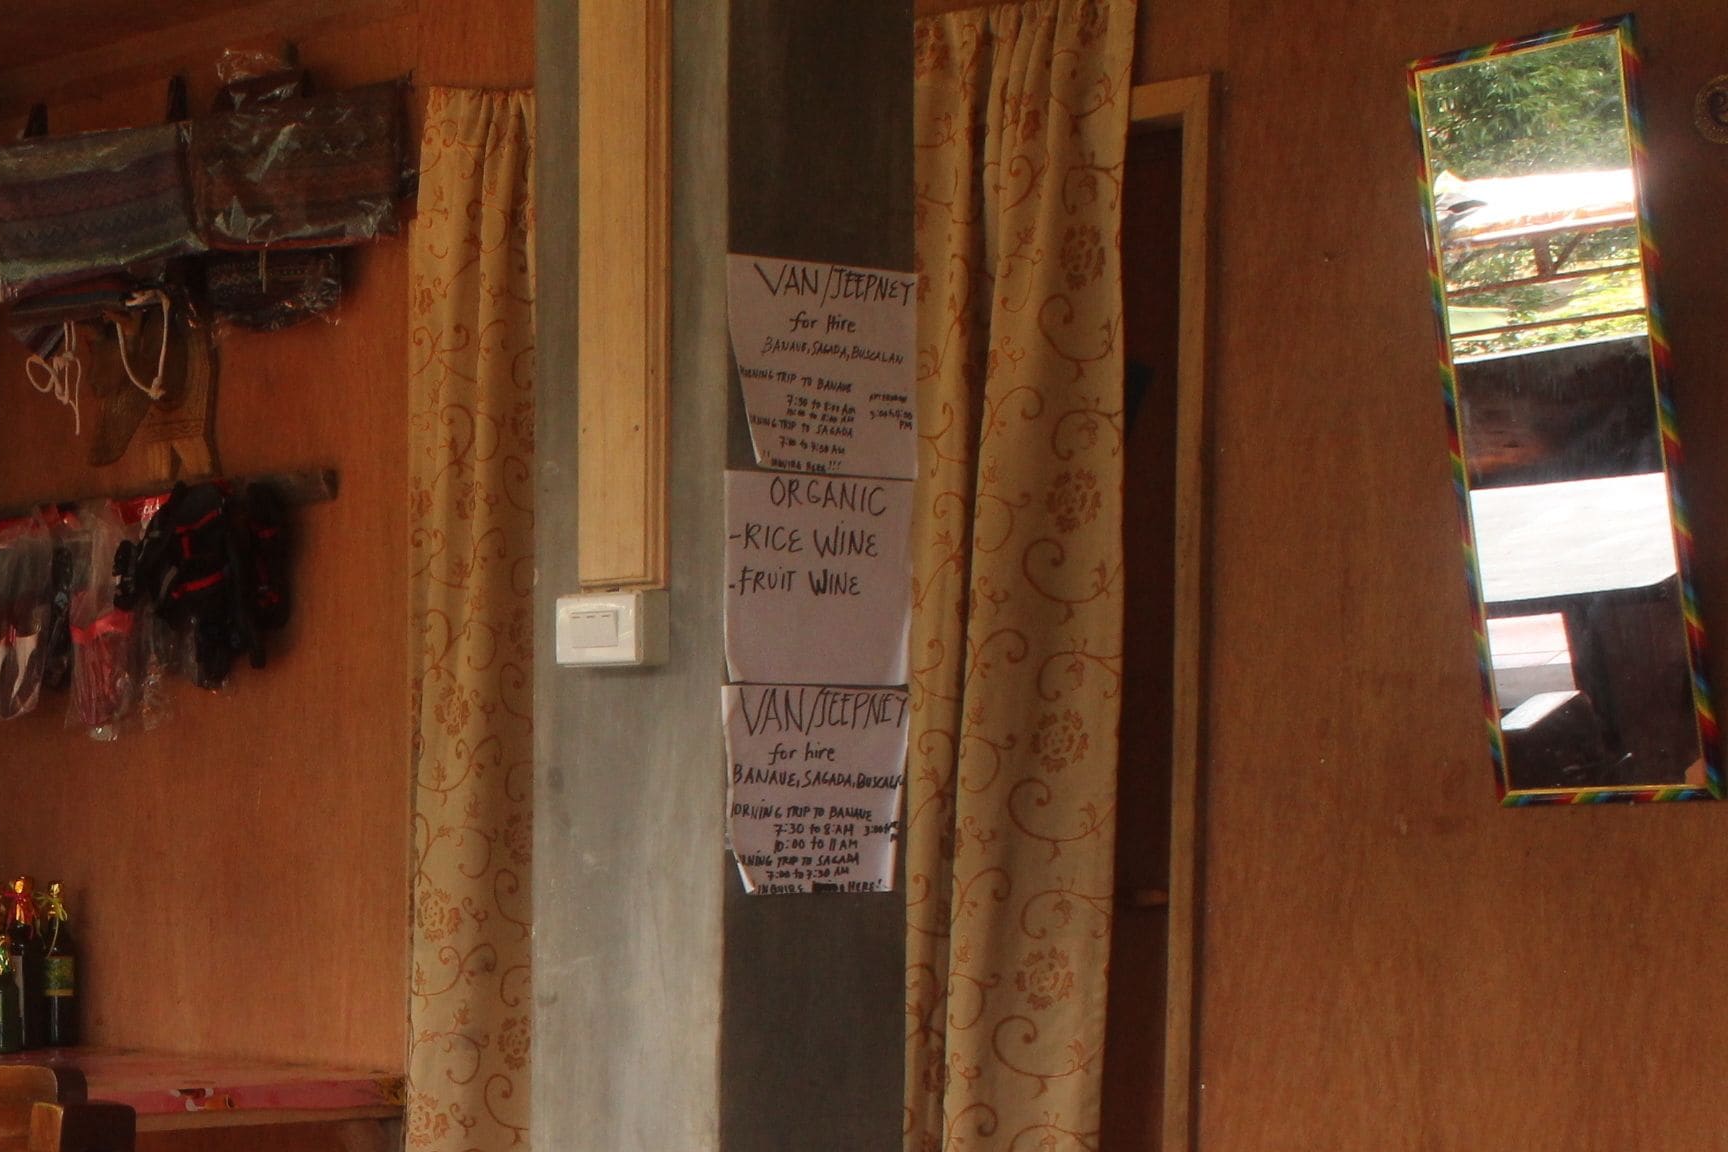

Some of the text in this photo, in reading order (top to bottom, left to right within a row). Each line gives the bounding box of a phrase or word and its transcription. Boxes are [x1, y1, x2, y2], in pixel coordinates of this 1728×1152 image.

[789, 311, 817, 333] for
[777, 371, 797, 385] TRIP
[801, 377, 812, 387] TO
[770, 476, 888, 516] ORGANIC
[813, 522, 878, 557] WINE
[808, 569, 861, 596] WINE
[769, 742, 836, 765] for hire
[787, 806, 810, 818] TRIP
[813, 807, 824, 819] TO
[829, 805, 872, 822] BANAUE
[773, 823, 804, 836] 7:30
[810, 823, 821, 834] to
[811, 836, 824, 850] to
[816, 852, 860, 867] SAGADA
